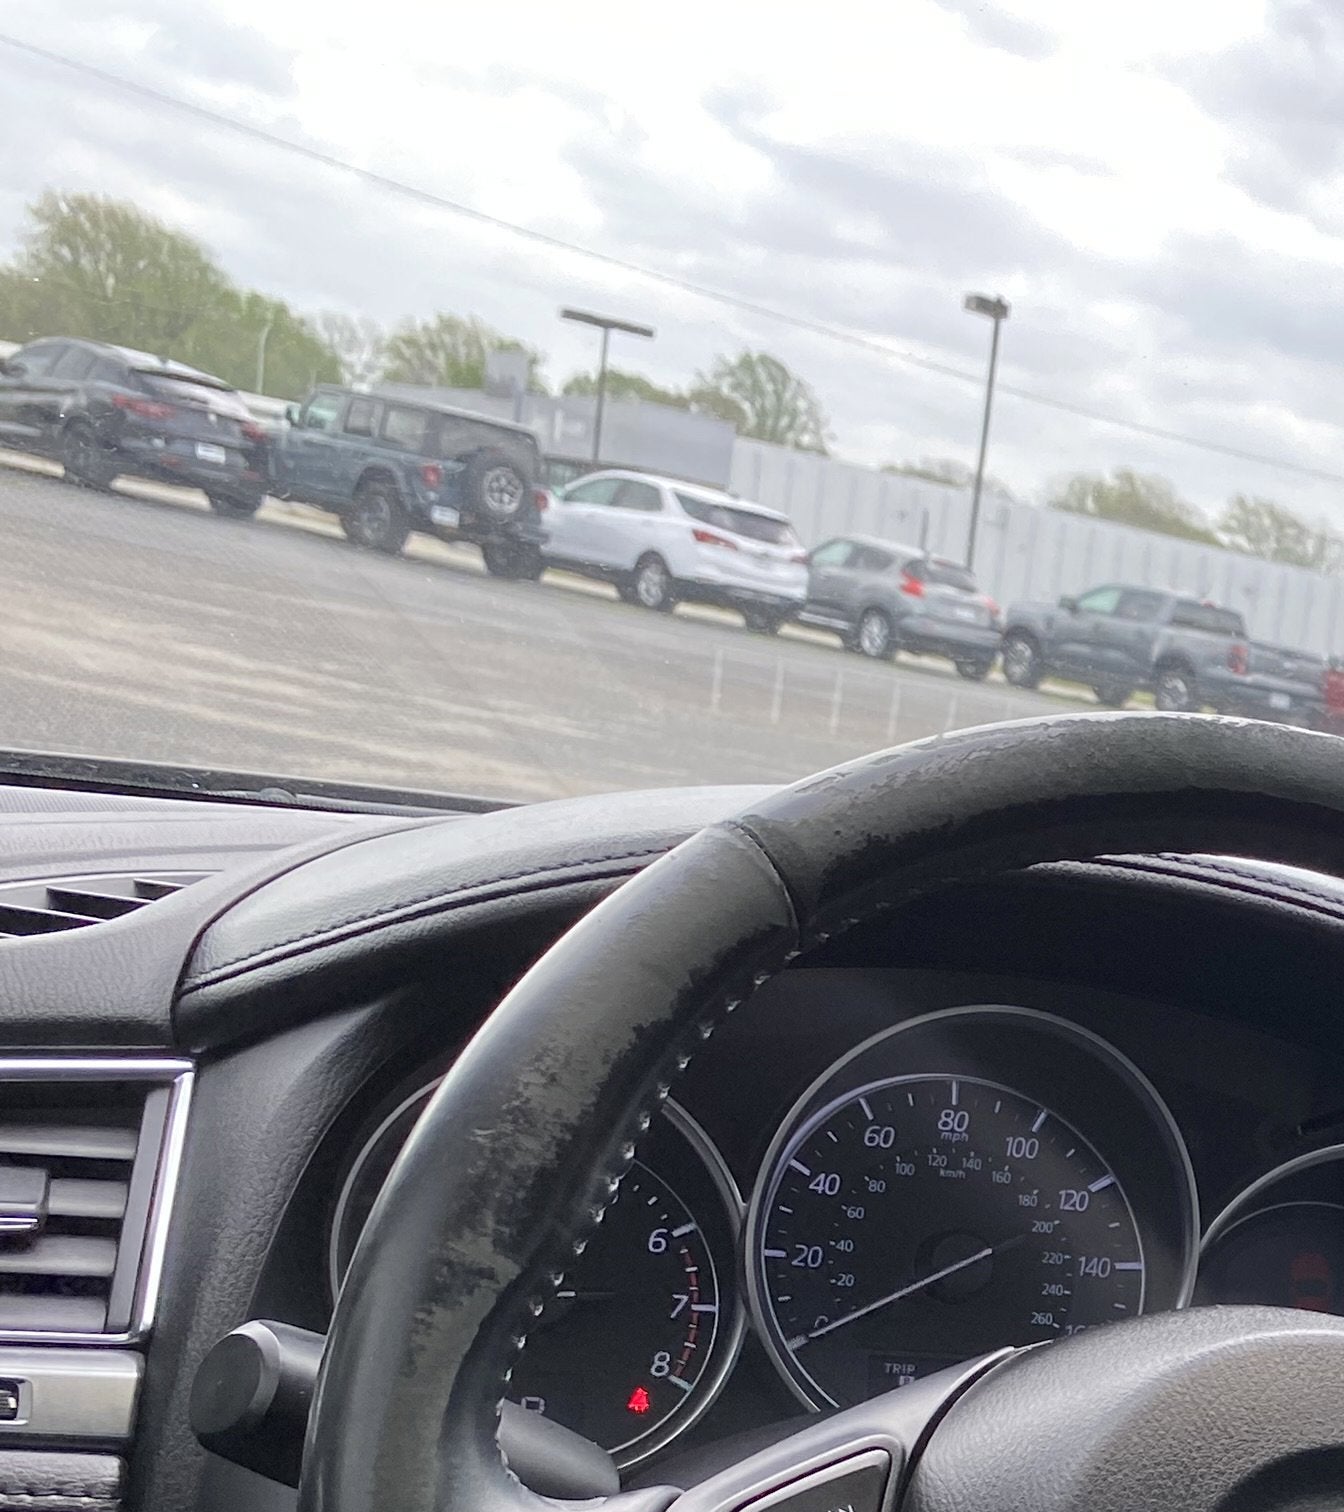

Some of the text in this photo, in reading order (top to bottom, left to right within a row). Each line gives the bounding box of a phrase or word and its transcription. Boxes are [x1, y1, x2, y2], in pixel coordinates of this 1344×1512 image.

[937, 1110, 969, 1131] 80
[864, 1127, 895, 1148] 60
[940, 1131, 968, 1143] mph
[1005, 1137, 1039, 1158] 100
[927, 1154, 948, 1168] 120
[961, 1156, 982, 1170] 140
[895, 1162, 915, 1176] 100
[939, 1168, 966, 1181] km/h
[808, 1173, 841, 1195] 40
[991, 1170, 1011, 1184] 160
[868, 1179, 886, 1193] 80
[1018, 1194, 1038, 1207] 180
[1058, 1190, 1089, 1212] 120
[847, 1206, 864, 1219] 60
[1031, 1220, 1053, 1233] 200
[648, 1228, 668, 1253] 6
[835, 1239, 853, 1252] 40
[792, 1245, 823, 1268] 20
[1042, 1252, 1063, 1265] 220
[1078, 1256, 1111, 1278] 140
[836, 1274, 854, 1287] 20
[1042, 1284, 1063, 1297] 240
[670, 1293, 690, 1319] 7
[1031, 1313, 1053, 1326] 260
[650, 1351, 671, 1378] 8
[885, 1362, 915, 1374] TRIP
